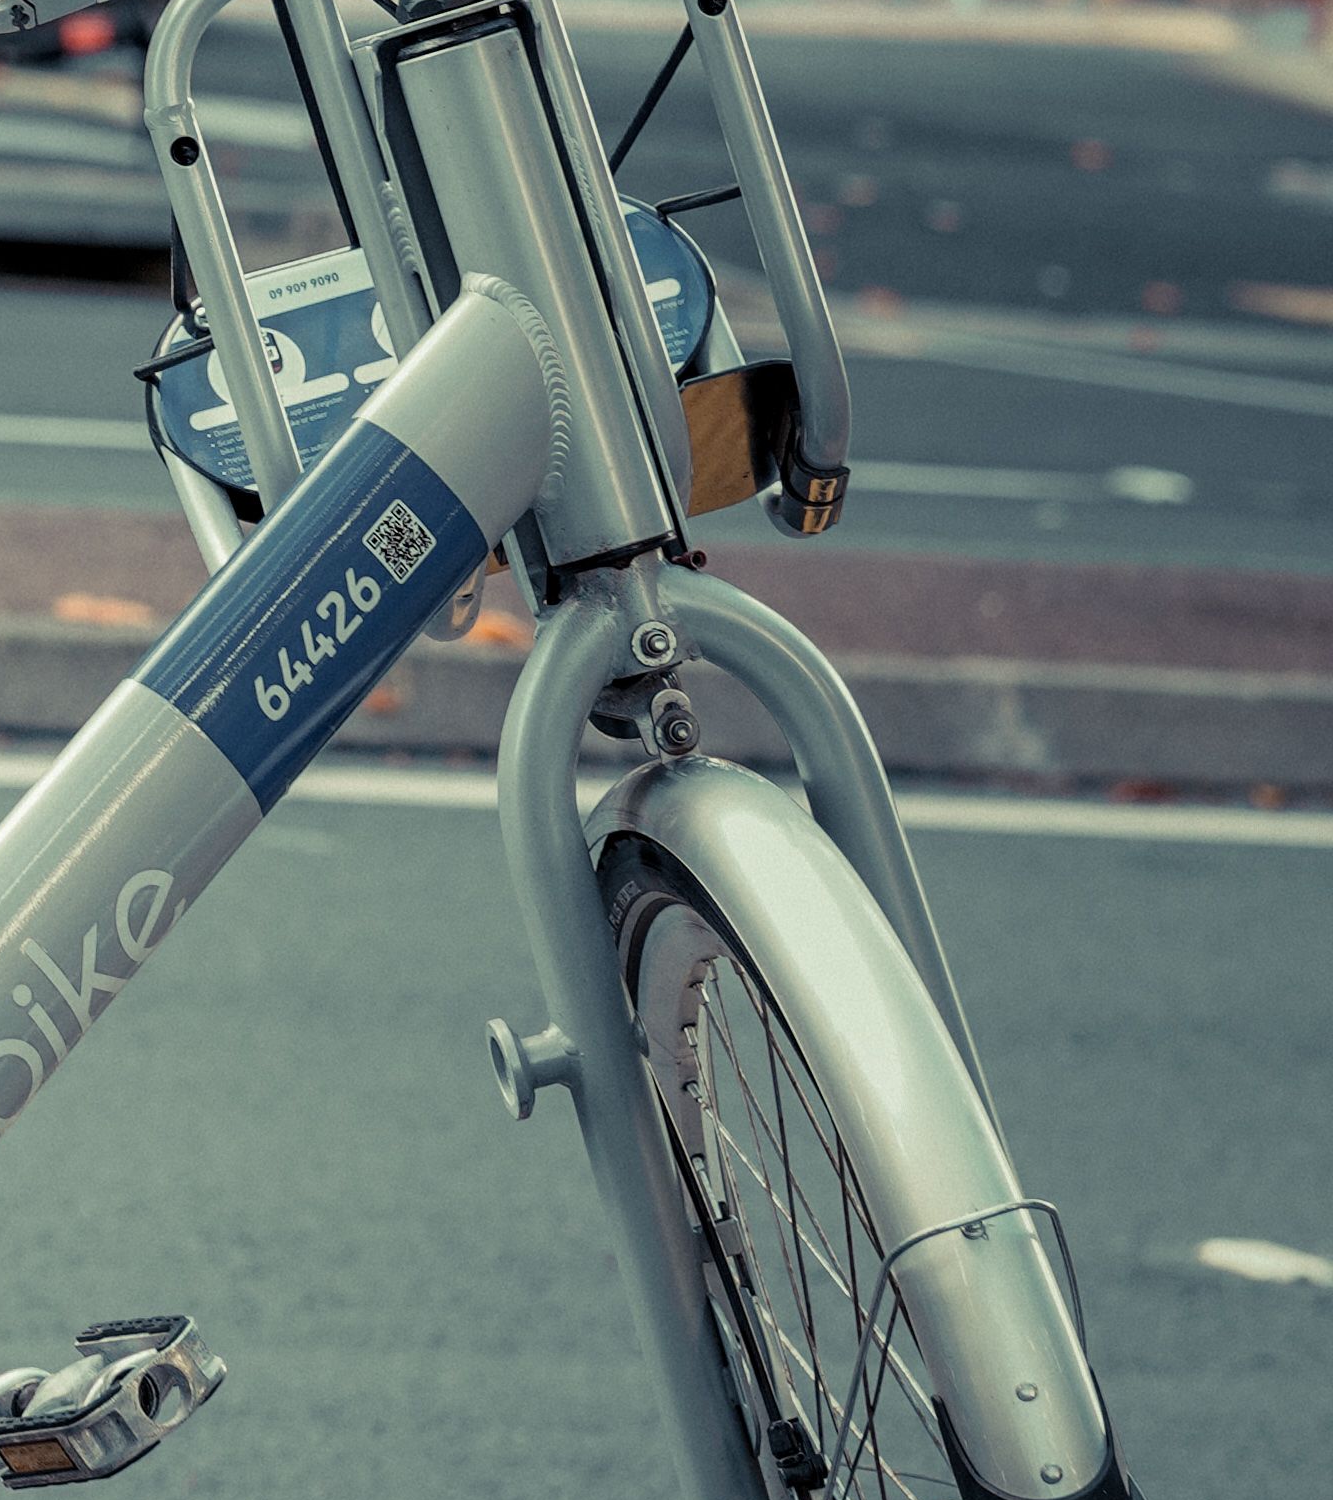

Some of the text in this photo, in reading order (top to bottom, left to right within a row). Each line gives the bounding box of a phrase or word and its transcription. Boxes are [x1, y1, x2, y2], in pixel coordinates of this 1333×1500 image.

[269, 272, 339, 299] 09 909 9090
[254, 567, 381, 722] 64426
